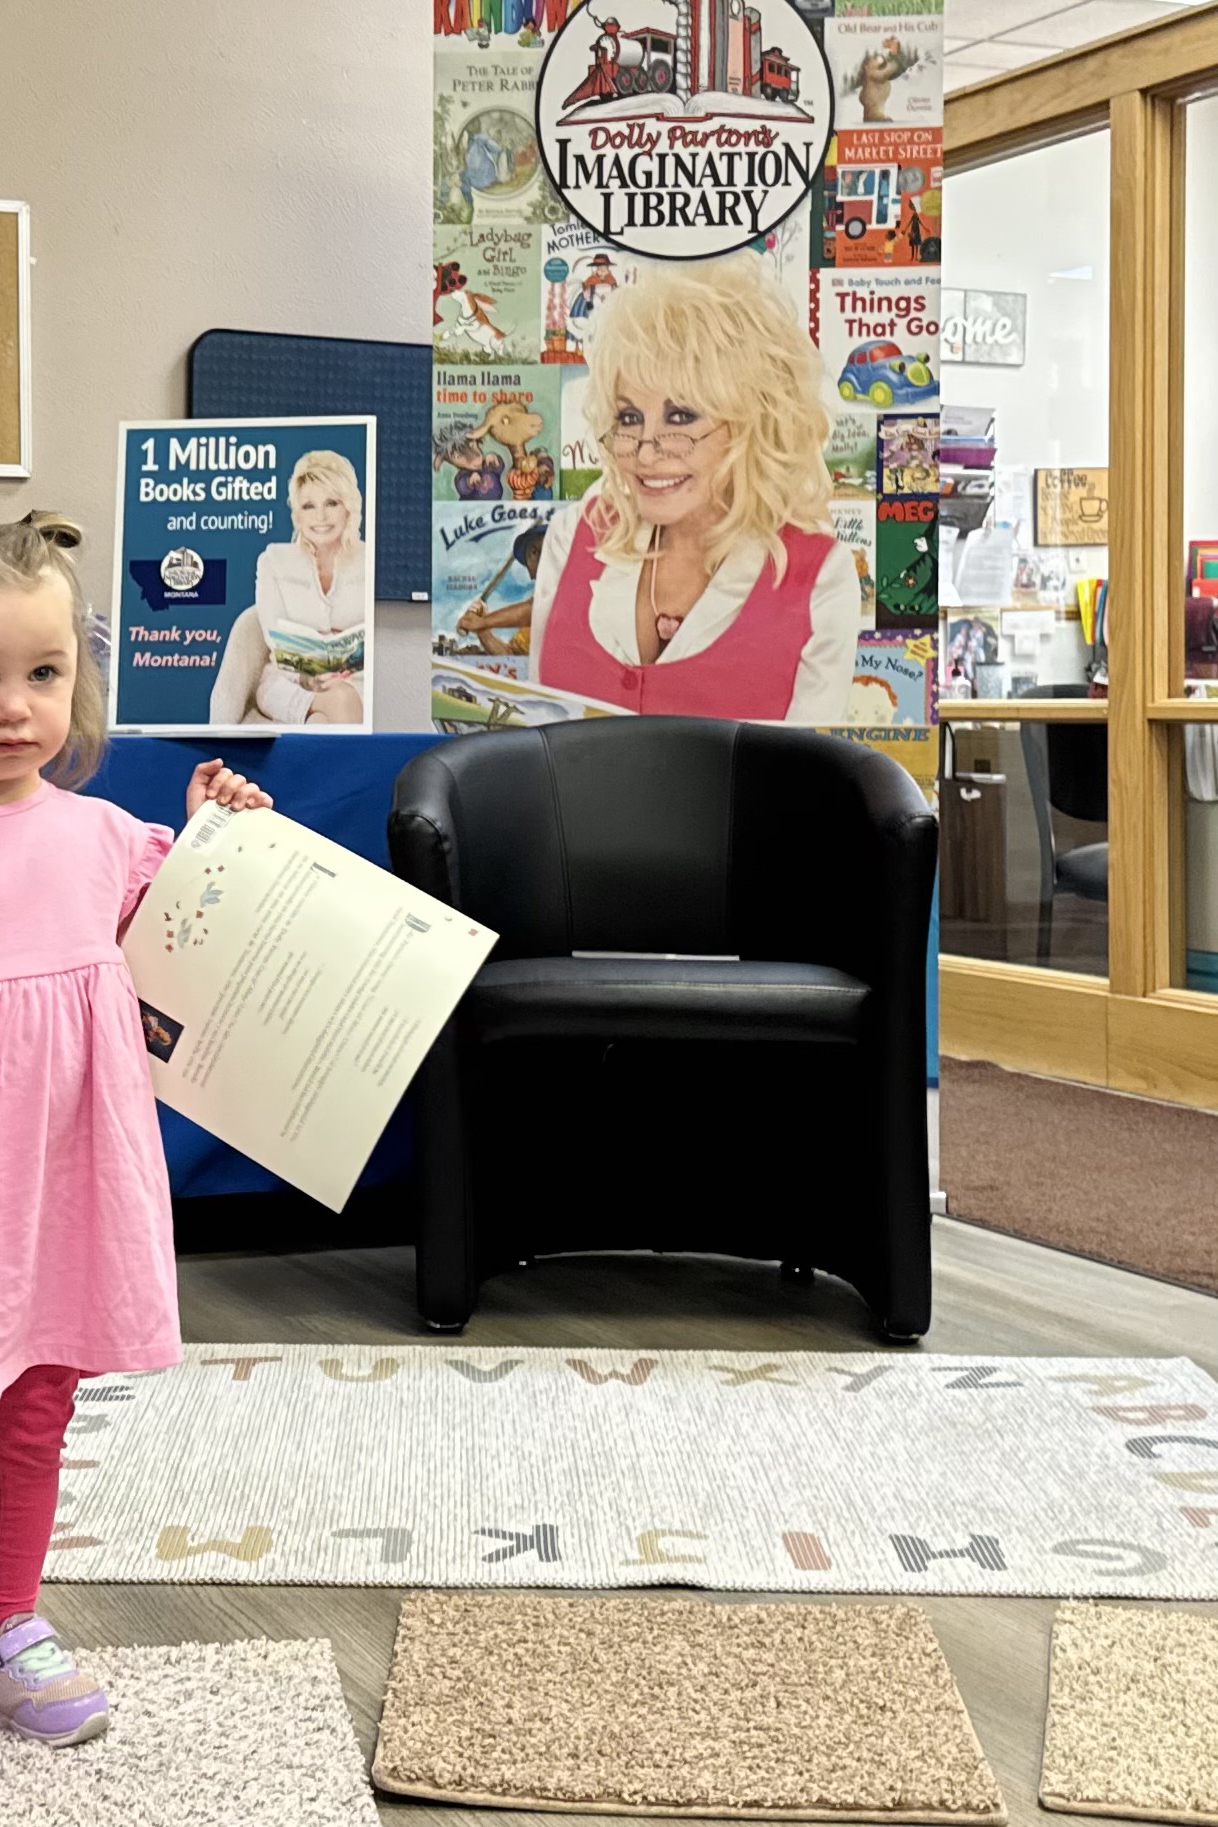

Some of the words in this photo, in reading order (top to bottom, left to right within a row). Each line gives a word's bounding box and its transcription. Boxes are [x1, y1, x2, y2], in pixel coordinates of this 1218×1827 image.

[898, 22, 915, 33] His
[917, 21, 939, 32] Cub
[466, 65, 488, 77] THE
[491, 64, 519, 76] TALE
[520, 65, 534, 76] OF
[452, 78, 495, 93] PETER
[500, 78, 537, 92] RABB
[588, 122, 661, 156] Dolly
[668, 124, 780, 150] Parton's
[853, 132, 880, 145] LAST
[884, 131, 911, 144] STOP
[914, 130, 933, 143] ON
[844, 145, 895, 161] MARKET
[897, 144, 943, 159] STREET
[554, 138, 815, 191] IMAGINATION
[600, 190, 769, 237] LIBRARY
[468, 227, 533, 249] Ladybug
[550, 219, 588, 237] Tomi
[547, 230, 600, 255] MOTHER
[493, 264, 527, 278] Bingo
[848, 278, 872, 288] Baby
[875, 277, 901, 287] Touch
[904, 277, 922, 286] and
[925, 276, 941, 286] Fee
[835, 290, 927, 319] Things
[844, 317, 898, 338] That
[906, 316, 940, 337] Go
[436, 370, 477, 386] llama
[481, 370, 522, 386] llama
[436, 388, 468, 403] time
[472, 390, 487, 404] to
[491, 388, 534, 404] share
[140, 437, 159, 472] 1
[169, 436, 277, 471] Million
[139, 477, 206, 502] Books
[211, 475, 277, 501] Gifted
[1045, 468, 1088, 489] Coffee
[167, 512, 196, 531] and
[200, 510, 273, 534] counting!
[877, 500, 935, 523] MEG
[439, 513, 486, 552] Luke
[491, 504, 538, 523] Goes
[129, 625, 181, 642] Thank
[184, 627, 222, 647] you,
[132, 651, 217, 668] Montana!
[861, 654, 881, 671] My
[885, 656, 924, 682] Nose?
